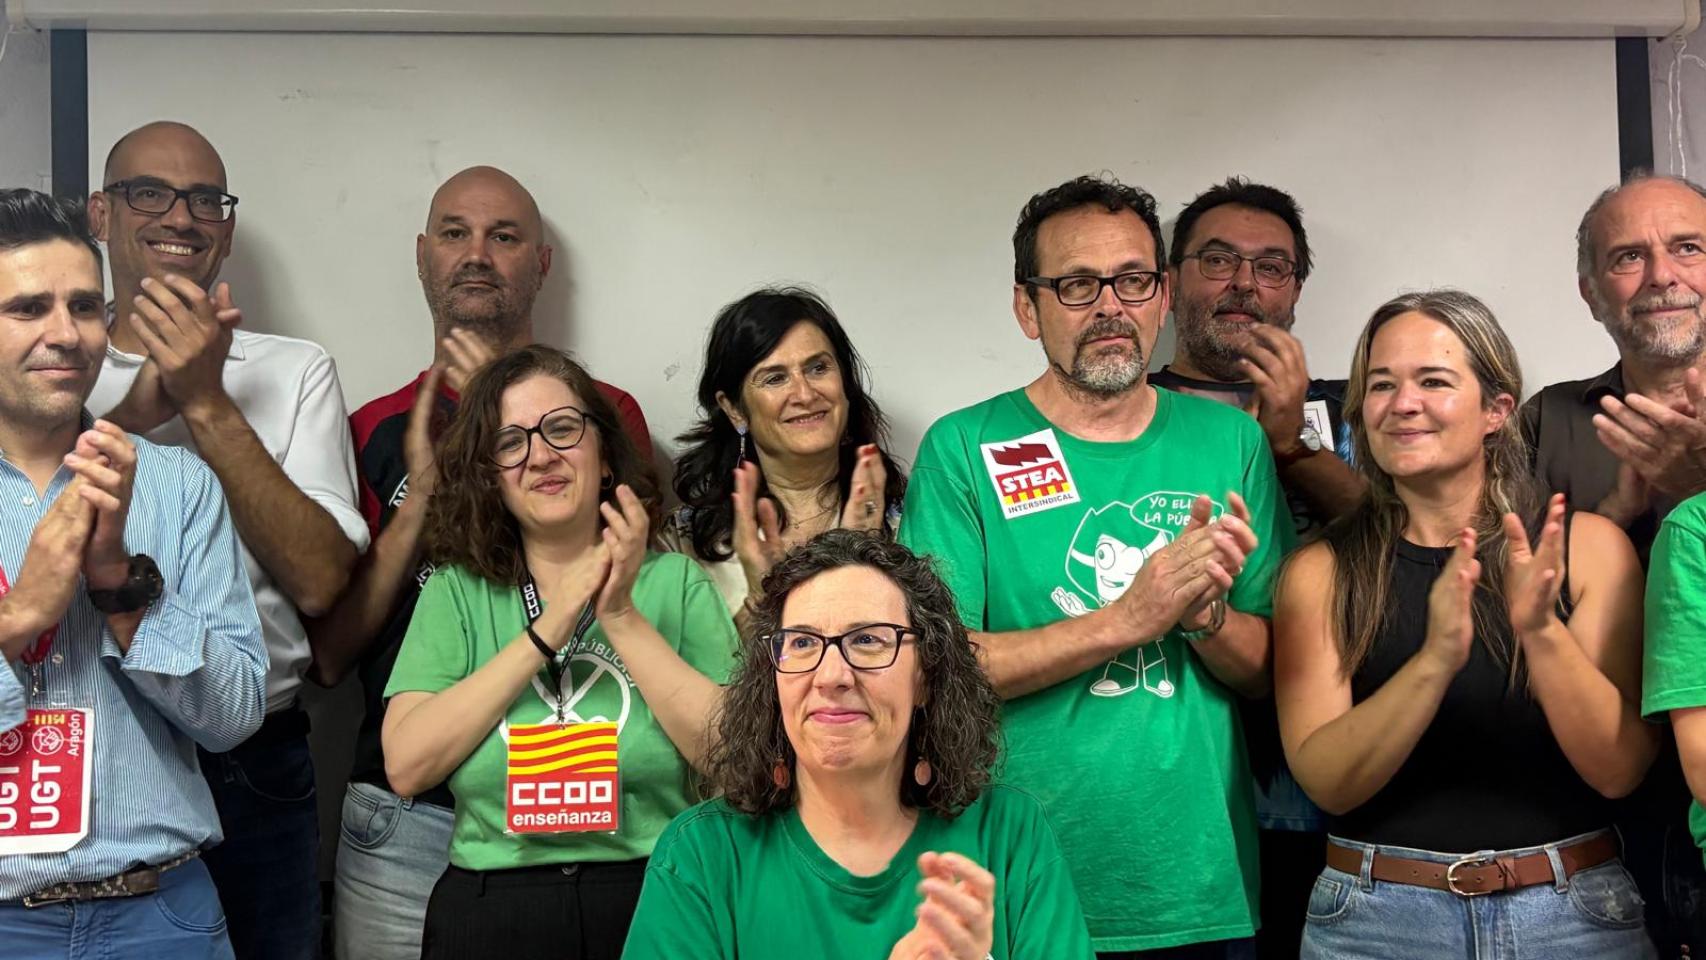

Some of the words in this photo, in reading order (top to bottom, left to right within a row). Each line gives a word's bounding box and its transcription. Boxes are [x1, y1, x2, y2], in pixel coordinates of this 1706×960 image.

[1001, 466, 1064, 494] STEA
[1008, 493, 1074, 514] INTERSINDICAL
[1149, 496, 1167, 509] YO
[1144, 512, 1162, 524] LA
[523, 583, 541, 619] CCOO
[67, 713, 83, 757] Aragón
[30, 759, 62, 829] UGT
[512, 780, 613, 806] CCOO
[512, 808, 612, 827] enseñanza
